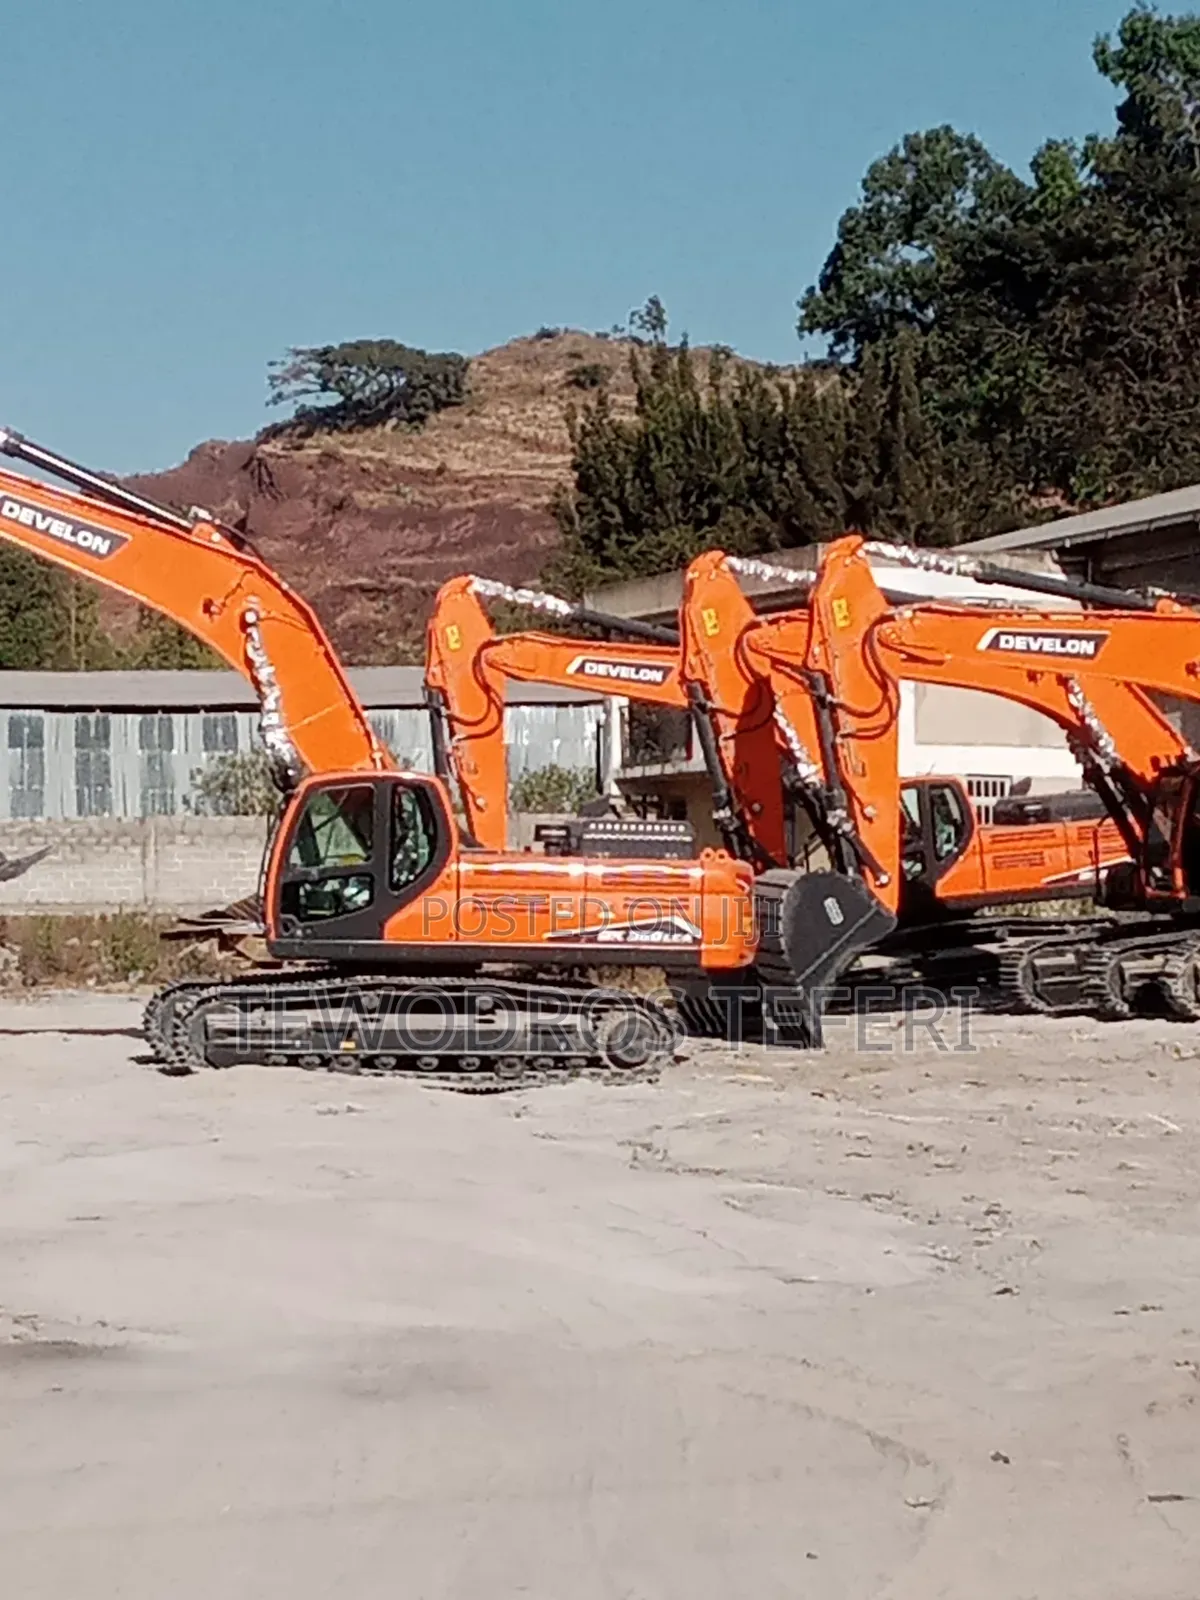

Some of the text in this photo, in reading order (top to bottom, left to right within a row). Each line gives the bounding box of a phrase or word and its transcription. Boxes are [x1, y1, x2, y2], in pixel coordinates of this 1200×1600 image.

[1, 500, 111, 555] DEVELON
[998, 634, 1096, 655] DEVELON
[584, 662, 664, 682] DEVELON
